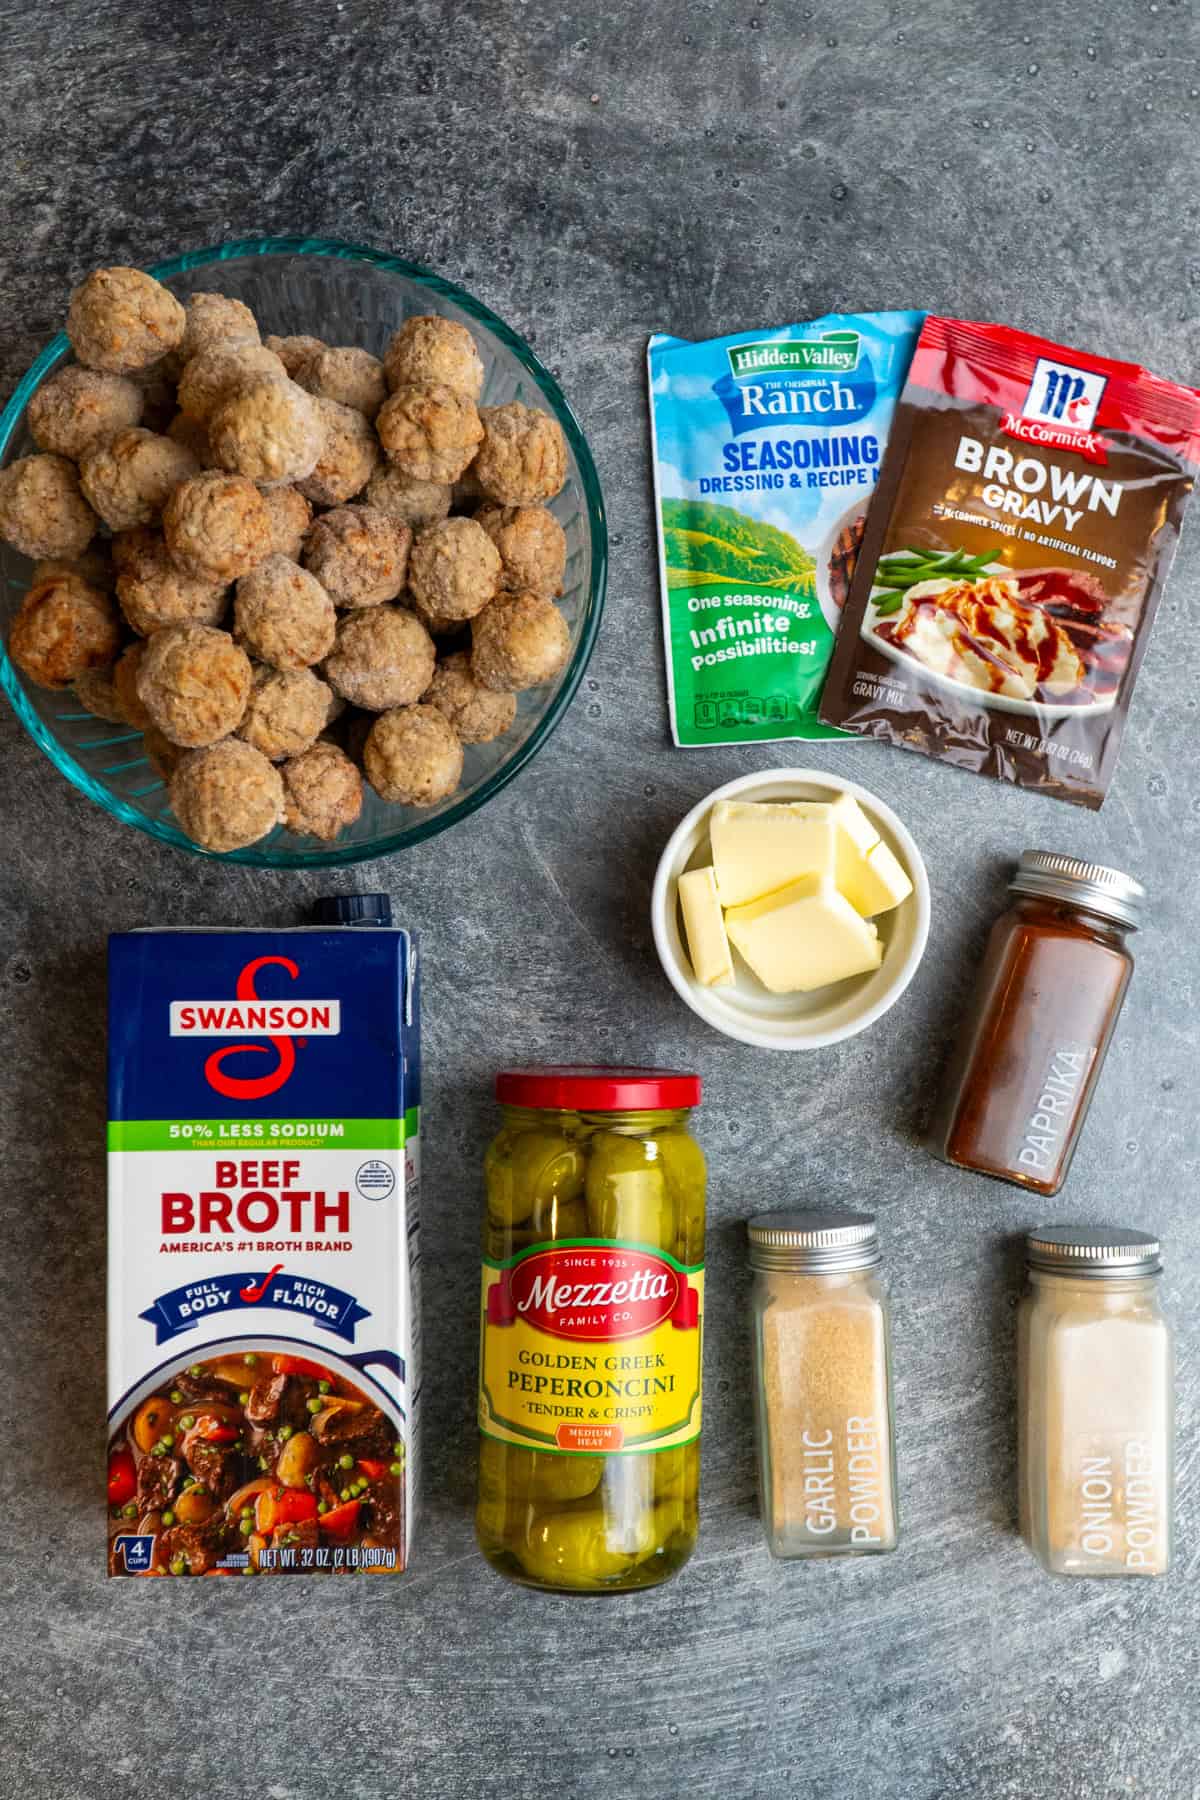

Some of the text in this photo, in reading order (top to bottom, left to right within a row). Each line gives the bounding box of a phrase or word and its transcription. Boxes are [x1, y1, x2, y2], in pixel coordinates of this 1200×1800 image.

[736, 347, 853, 370] Hidden Valley
[739, 381, 856, 416] Ranch
[1005, 413, 1097, 453] McCormick
[722, 435, 879, 473] SEASONING
[701, 473, 784, 494] DRESSING
[790, 475, 802, 488] &
[809, 468, 867, 488] RECIPE
[954, 436, 1124, 517] BROWN
[982, 484, 1084, 532] GRAVY
[1023, 530, 1036, 542] NO
[1037, 535, 1080, 556] ARTIFICIAL
[1081, 548, 1118, 569] FLAVORS
[688, 594, 812, 619] One seasoning,
[689, 612, 791, 649] Infinite
[852, 680, 905, 706] GRAVY MIX
[1006, 728, 1024, 745] NET
[1024, 734, 1039, 750] WT
[180, 1007, 330, 1030] SWANSON
[1018, 1051, 1086, 1169] PAPRIKA
[169, 1123, 344, 1138] 50% LESS SODIUM
[215, 1160, 300, 1189] BEEF
[161, 1191, 350, 1234] BROTH
[159, 1241, 353, 1254] AMERICA'S #1 BROTH BRAND
[564, 1258, 628, 1268] SINCE 1935
[185, 1283, 220, 1300] FULL
[293, 1281, 326, 1298] RICH
[517, 1268, 669, 1313] Mezzetta
[178, 1290, 232, 1318] BODY
[273, 1289, 340, 1320] FLAVOR
[559, 1312, 633, 1327] FAMILY CO.
[518, 1350, 665, 1371] GOLDEN GREEK
[508, 1370, 675, 1399] PEPERONCINI
[526, 1401, 654, 1418] TENDER & CRISPY
[569, 1429, 612, 1437] MEDIUM
[577, 1438, 604, 1446] HEAT
[802, 1428, 837, 1534] GARLIC
[846, 1415, 881, 1543] POWDER
[1081, 1456, 1113, 1555] ONION
[1125, 1439, 1154, 1567] POWDER
[128, 1557, 148, 1565] CUPS
[130, 1541, 144, 1557] 4
[259, 1549, 277, 1568] NET
[279, 1549, 299, 1568] WT.
[301, 1548, 313, 1567] 32
[316, 1548, 332, 1567] OZ.
[334, 1548, 344, 1568] (2
